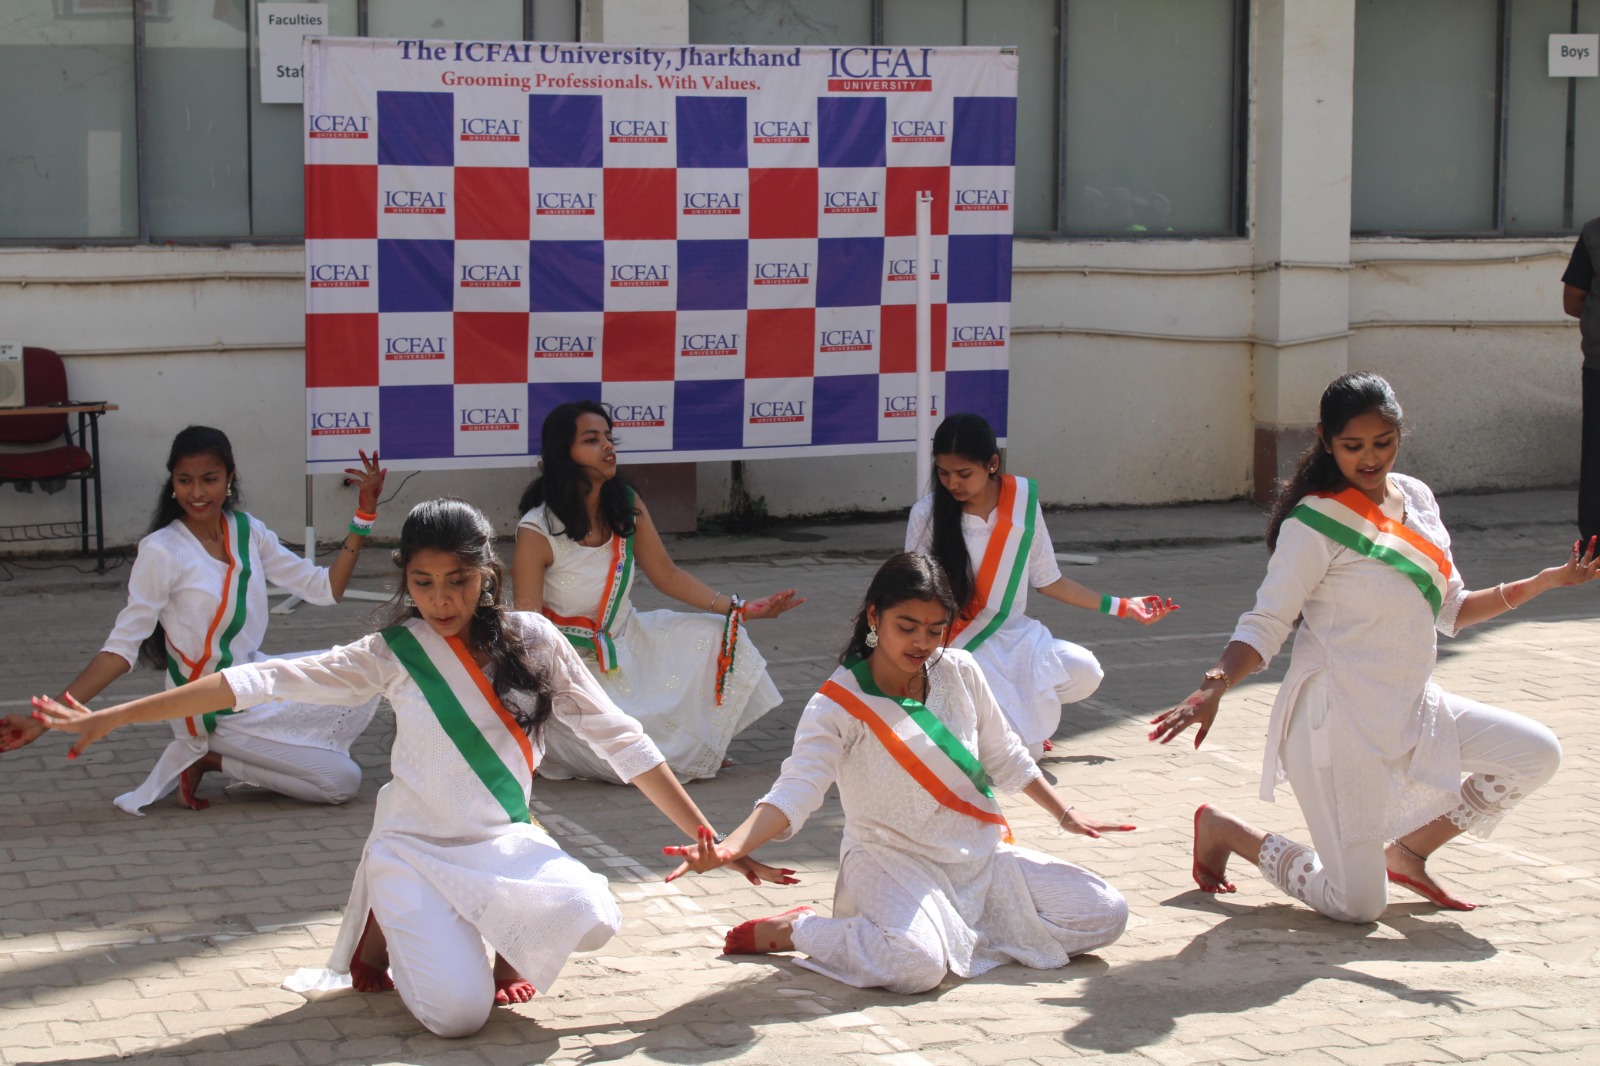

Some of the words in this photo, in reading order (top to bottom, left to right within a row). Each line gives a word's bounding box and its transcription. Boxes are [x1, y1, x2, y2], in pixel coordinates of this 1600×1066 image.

[268, 14, 323, 26] Faculties
[397, 40, 447, 61] The
[453, 42, 532, 62] ICFAI
[539, 45, 672, 71] University,
[675, 47, 801, 71] Jharkhand
[1561, 45, 1590, 60] Boys
[827, 47, 933, 78] ICFAI
[276, 64, 305, 78] Staf
[441, 71, 531, 92] Grooming
[535, 73, 653, 89] Professionals.
[656, 75, 698, 89] With
[701, 76, 761, 90] Values.
[843, 81, 917, 90] UNIVERSITY
[310, 115, 368, 131] ICFAI
[461, 118, 519, 134] ICFAI
[610, 120, 667, 136] ICFAI
[754, 121, 809, 137] ICFAI
[892, 121, 944, 136] ICFAI
[384, 191, 446, 207] ICFAI
[536, 193, 594, 208] ICFAI
[683, 193, 740, 208] ICFAI
[824, 192, 877, 206] ICFAI
[954, 190, 1008, 205] ICFAI
[311, 264, 369, 280] ICFAI
[461, 265, 520, 280] ICFAI
[611, 265, 668, 280] ICFAI
[754, 263, 808, 278] ICFAI
[888, 259, 940, 274] ICFI
[820, 330, 872, 346] ICFAI
[952, 326, 1005, 341] ICFAI
[385, 338, 445, 353] ICFAI
[535, 337, 593, 351] ICFAI
[682, 335, 738, 350] ICFAI
[750, 400, 804, 416] ICFAI
[884, 395, 937, 412] ICFI
[312, 412, 370, 428] ICFAI
[461, 408, 519, 424] ICFAI
[609, 405, 664, 421] ICFAI
